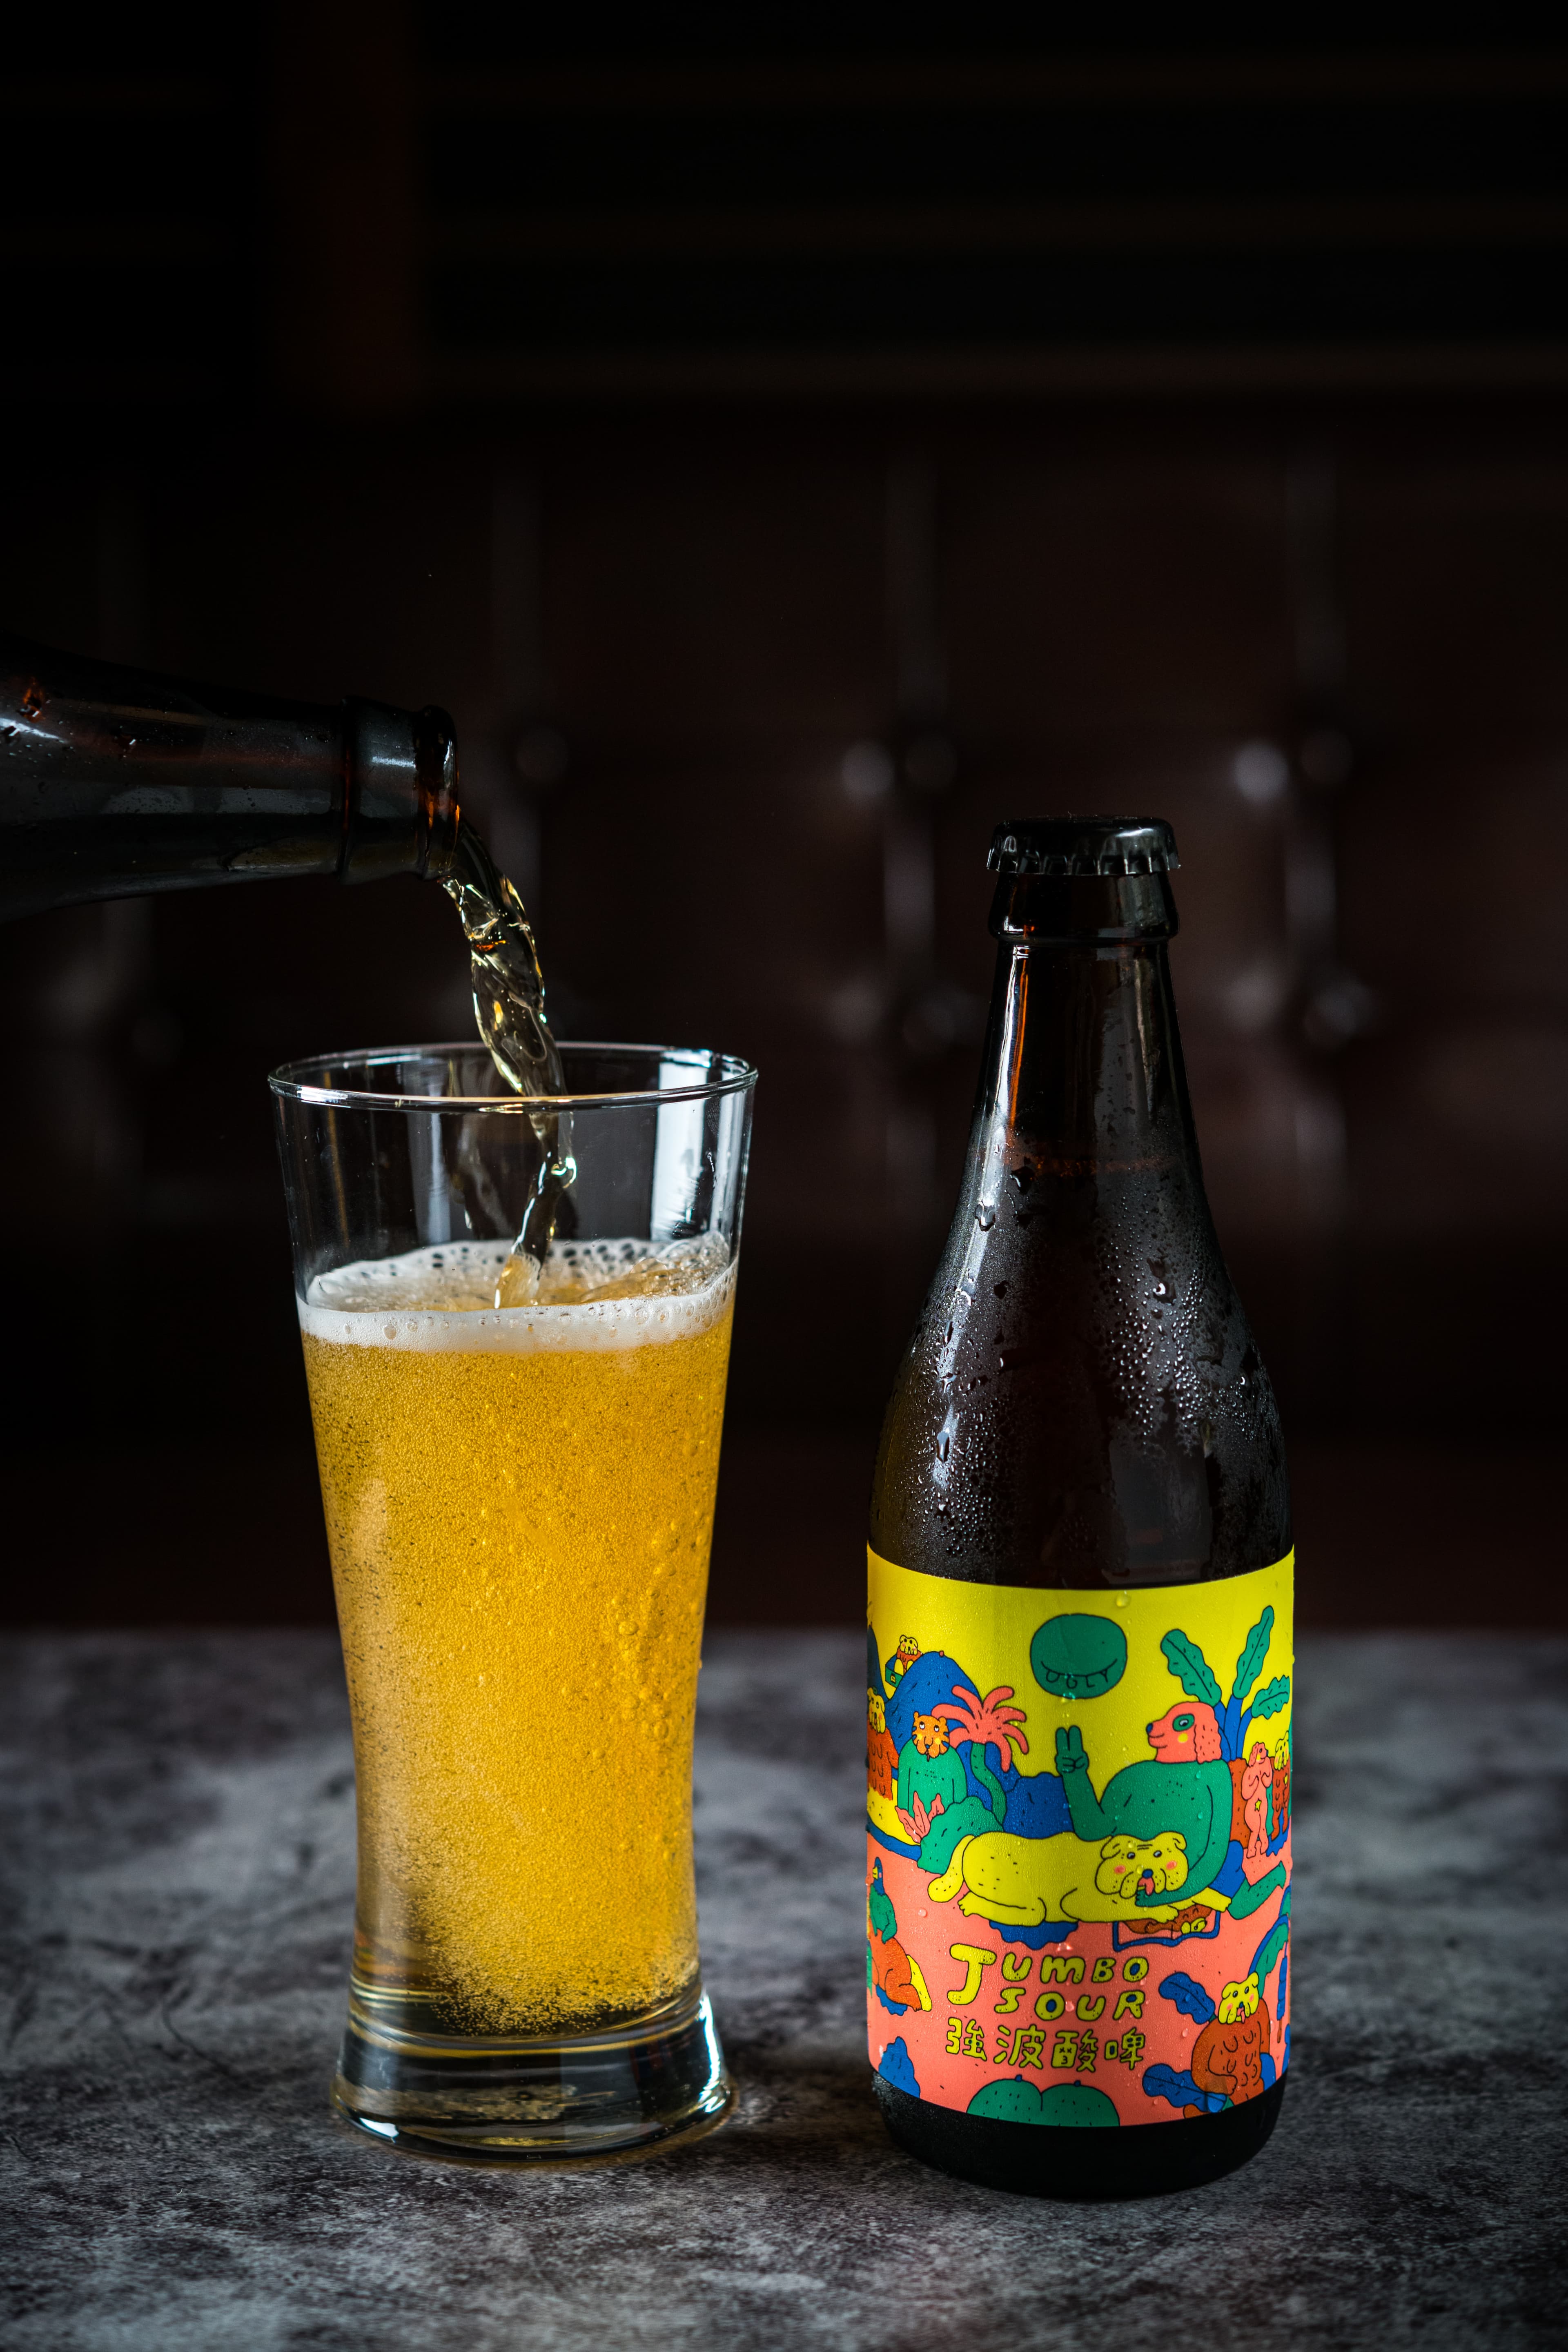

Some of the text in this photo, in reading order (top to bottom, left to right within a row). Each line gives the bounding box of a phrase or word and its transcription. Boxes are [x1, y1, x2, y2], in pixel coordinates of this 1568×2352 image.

[994, 1987, 1145, 2021] SOUR
[945, 2017, 1145, 2072] 強波酸啤
